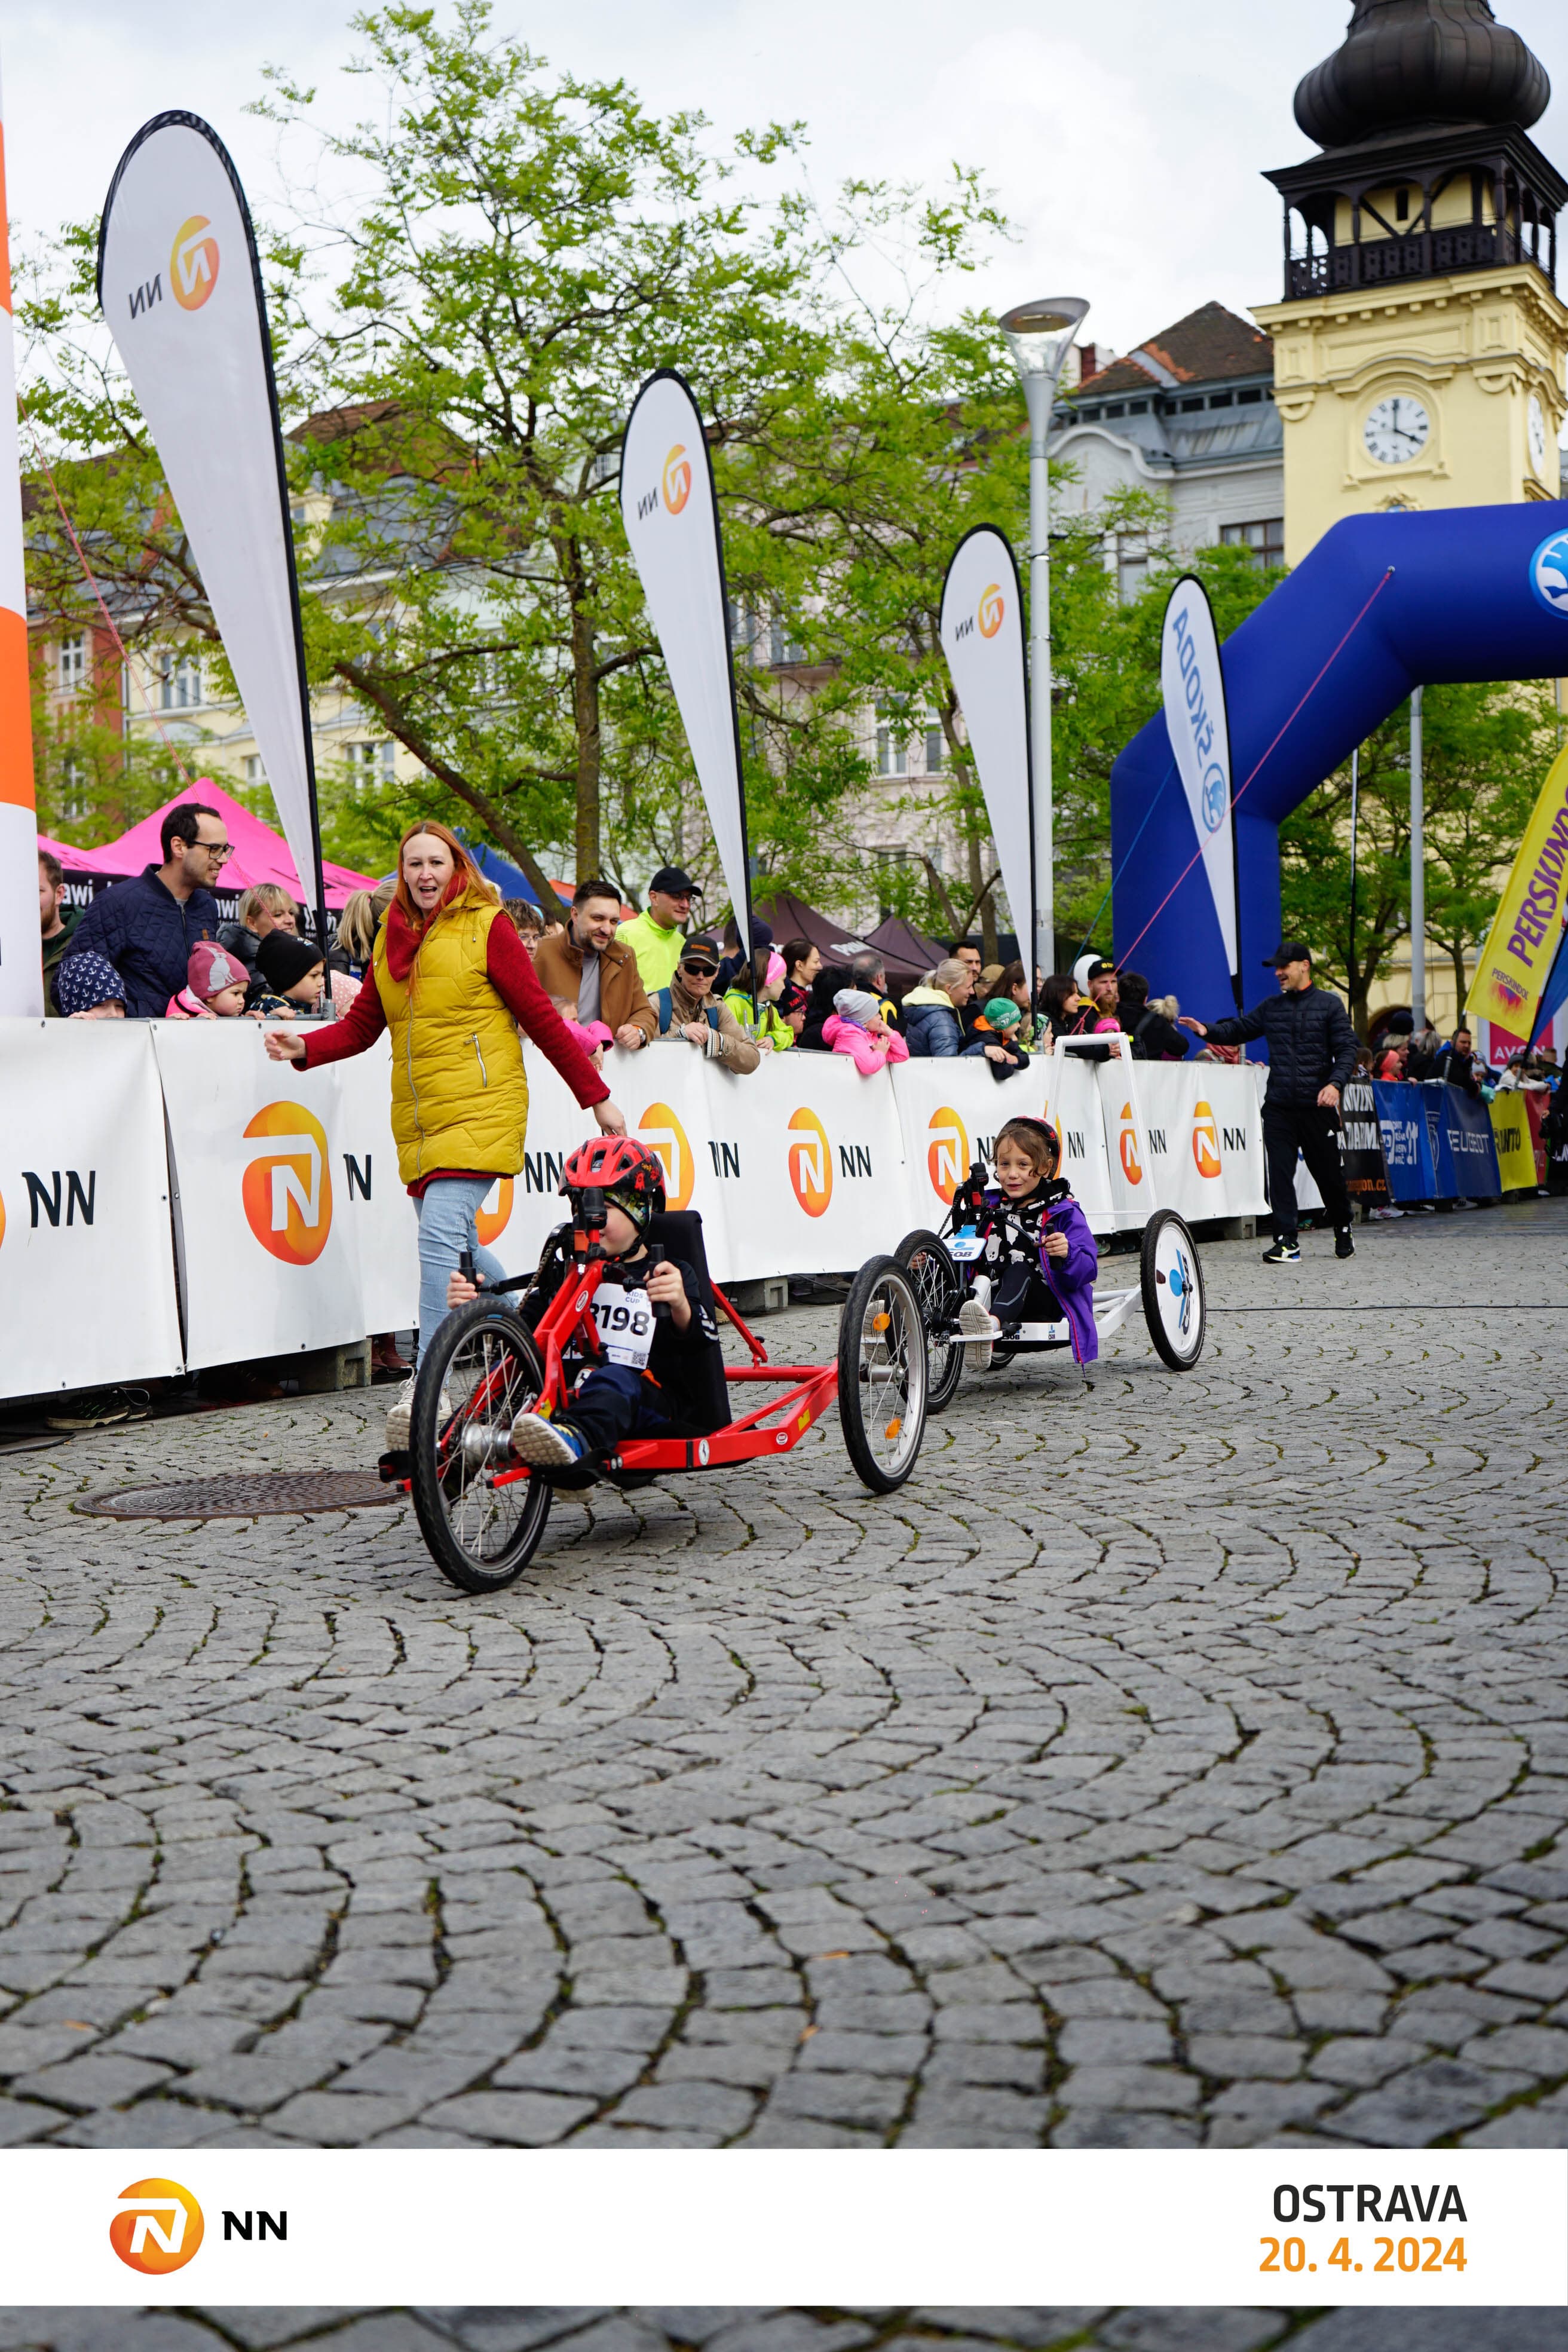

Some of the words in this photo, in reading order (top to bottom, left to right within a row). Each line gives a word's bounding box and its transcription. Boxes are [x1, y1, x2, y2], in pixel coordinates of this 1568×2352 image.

[1492, 967, 1529, 1001] PERSKINDOL
[1067, 1132, 1086, 1159] NN
[1148, 1129, 1168, 1154] NN
[1223, 1128, 1247, 1152] NN
[838, 1146, 872, 1178] NN
[22, 1170, 96, 1229] NN
